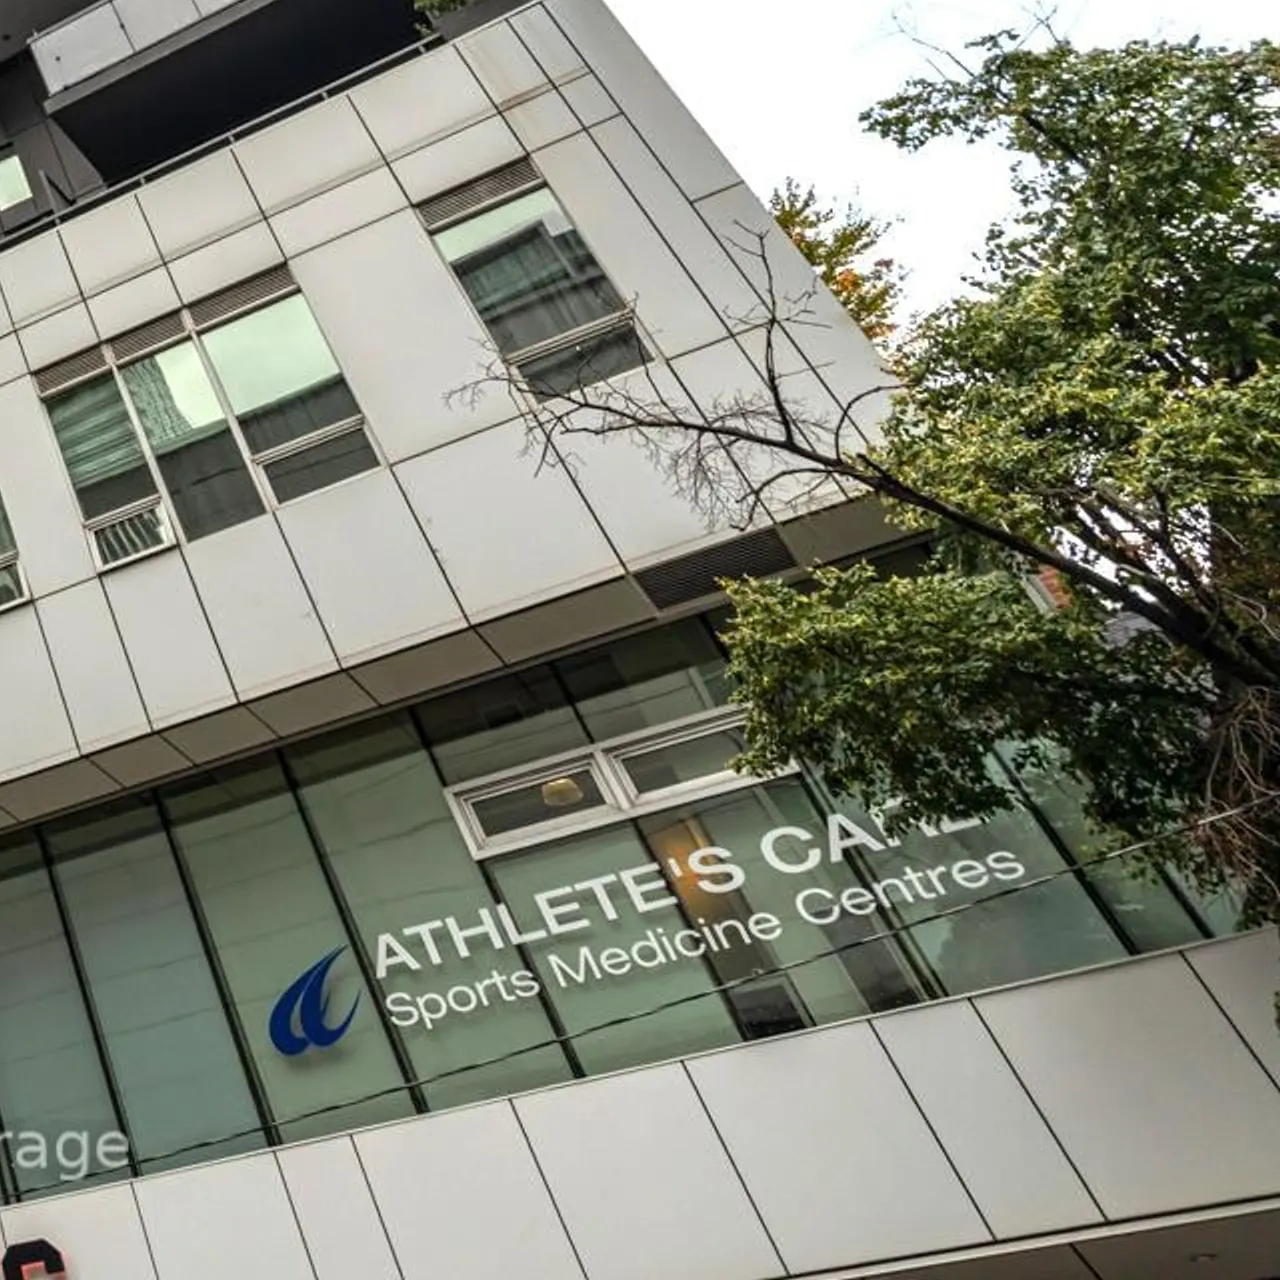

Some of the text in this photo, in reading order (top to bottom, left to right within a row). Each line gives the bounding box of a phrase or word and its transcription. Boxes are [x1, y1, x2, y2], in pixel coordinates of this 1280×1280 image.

[375, 846, 746, 980] ATHLETE'S
[384, 850, 1026, 1030] Sports Medicine Centres
